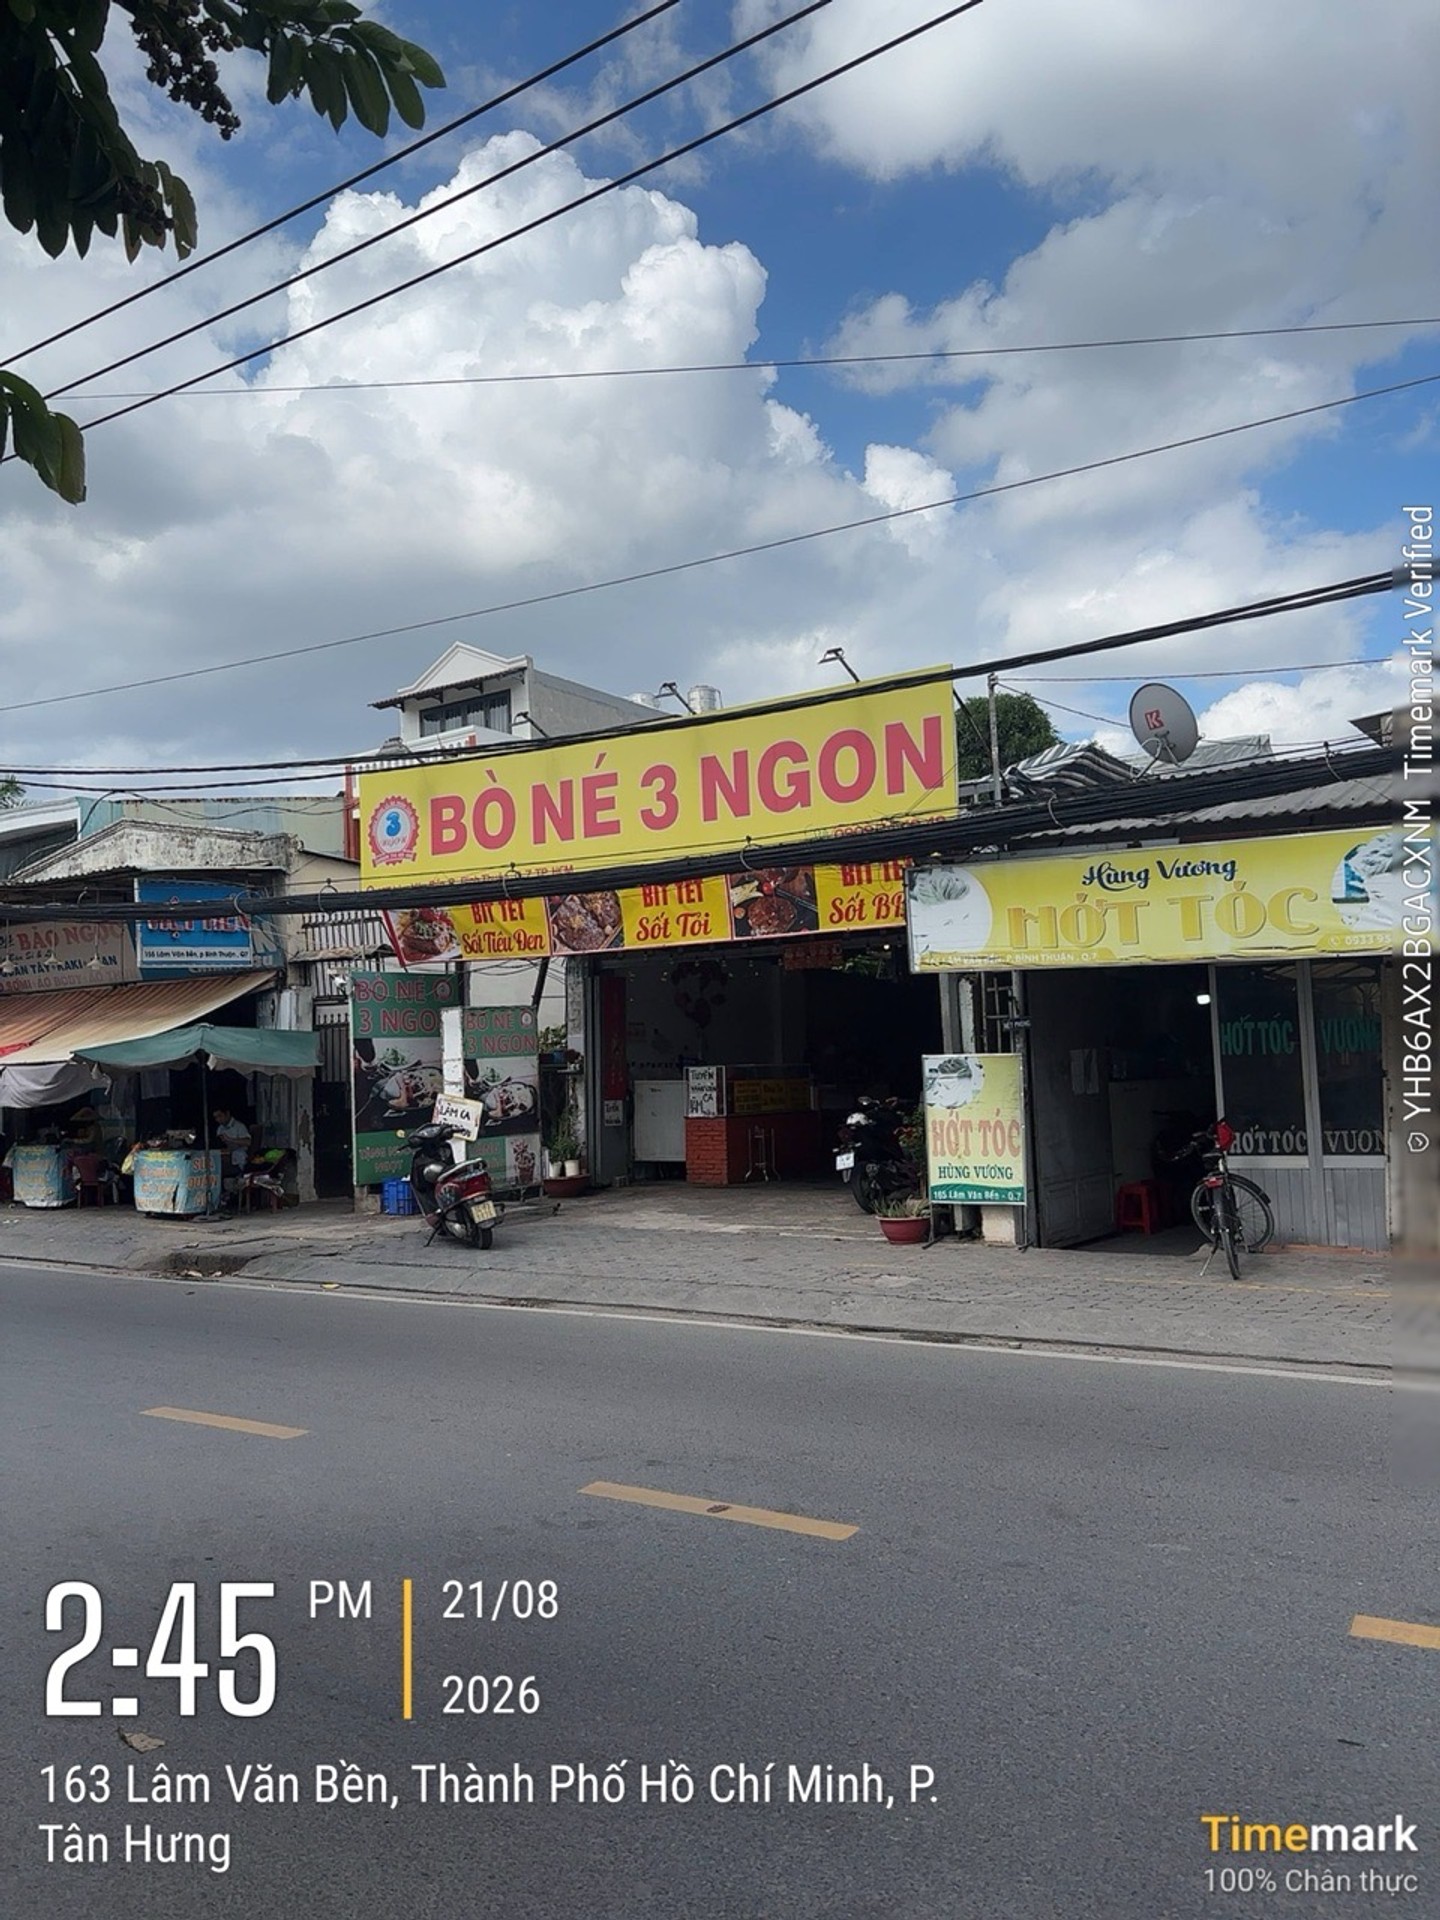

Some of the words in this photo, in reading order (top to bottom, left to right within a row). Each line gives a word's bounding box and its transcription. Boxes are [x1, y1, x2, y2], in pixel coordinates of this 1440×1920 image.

[430, 769, 516, 856] BÒ
[532, 752, 621, 845] NÉ
[640, 764, 679, 831] 3
[701, 715, 945, 822] NGON
[1081, 859, 1151, 893] Hùng
[1155, 857, 1238, 882] Vương
[828, 891, 867, 925] Sốt
[871, 890, 904, 920] BB
[1007, 892, 1150, 950] HỚT
[1167, 879, 1320, 942] TÓC
[483, 930, 514, 954] Tiêu
[513, 927, 545, 952] Đen
[636, 911, 673, 942] Sốt
[676, 911, 713, 938] Tỏi
[359, 1008, 374, 1034] 3
[380, 1008, 438, 1034] NGO
[467, 1036, 478, 1054] 3
[482, 1034, 537, 1053] NGON
[931, 1110, 973, 1158] HỚT
[977, 1108, 1020, 1158] TÓC
[938, 1163, 971, 1179] HÙNG
[974, 1164, 1014, 1180] VƯƠNG
